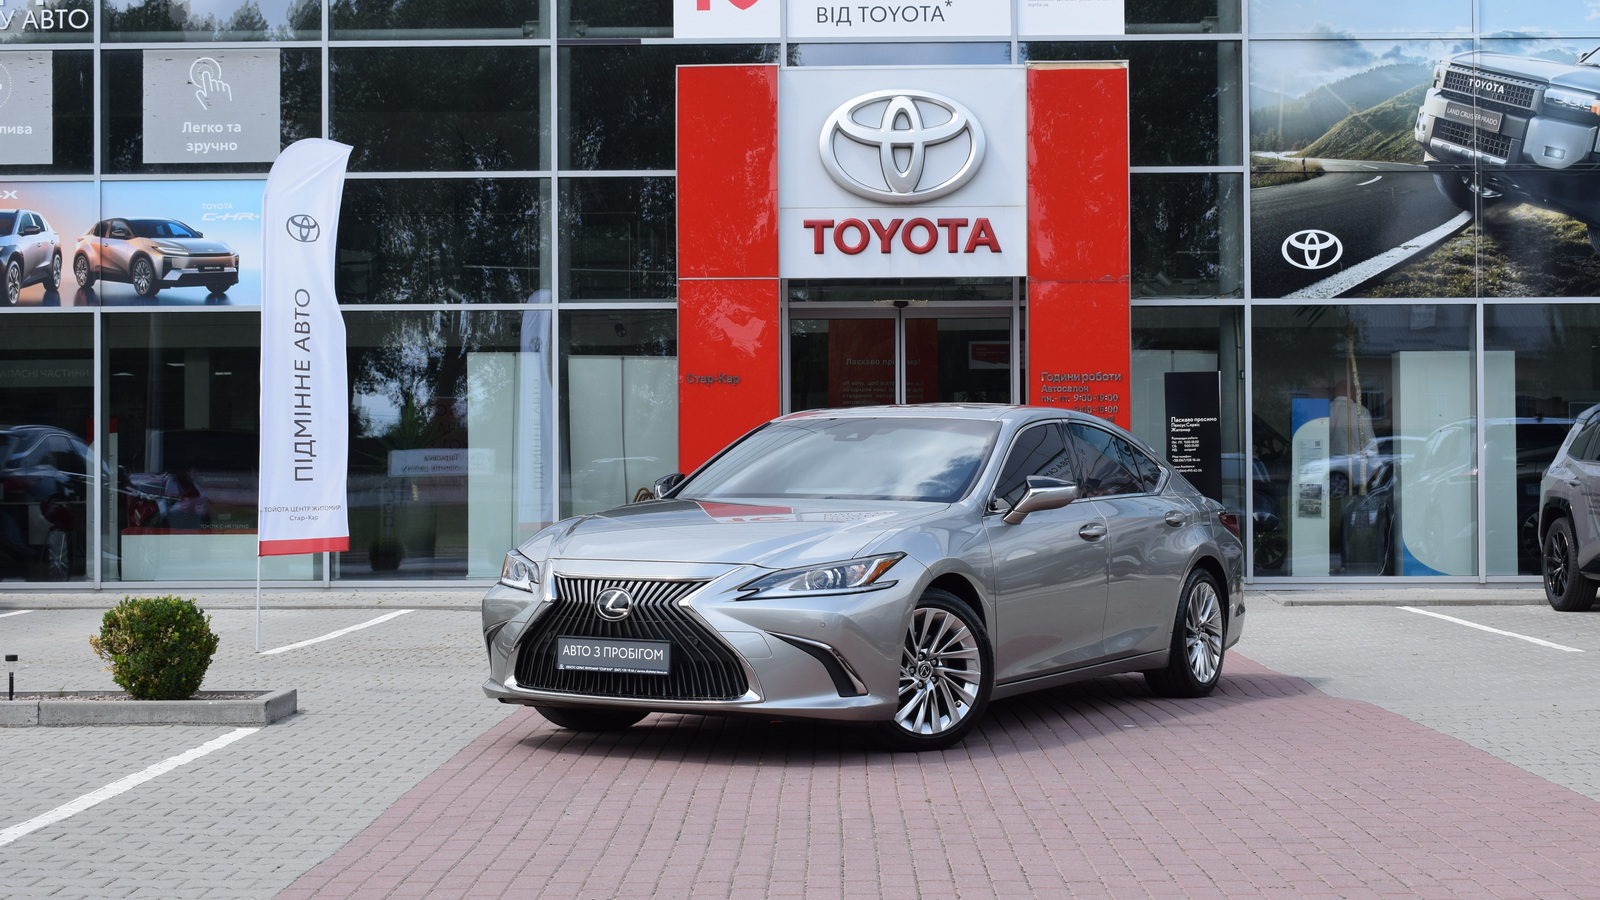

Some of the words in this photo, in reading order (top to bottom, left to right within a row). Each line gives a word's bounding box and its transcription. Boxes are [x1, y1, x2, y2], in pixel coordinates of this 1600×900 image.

[22, 8, 90, 30] АВТО
[816, 6, 852, 27] ВІД
[1469, 78, 1504, 94] TOYOTA
[1447, 108, 1460, 116] LAND
[1459, 110, 1481, 121] CRUISER
[1480, 115, 1498, 126] PRADO
[181, 121, 224, 134] Легко
[226, 123, 242, 133] та
[186, 142, 238, 154] зручно
[0, 189, 18, 200] X
[803, 217, 1002, 255] TOYOTA
[294, 288, 311, 353] АВТО
[882, 358, 921, 367] промо!
[40, 368, 89, 378] ЧАСТИНИ
[685, 373, 741, 385] Стар-Кар
[1041, 371, 1081, 384] Години
[1081, 370, 1122, 384] роботи
[1041, 384, 1090, 393] Автосалон
[1073, 393, 1119, 402] 9:00-19:00
[294, 359, 317, 481] ПІДМІННЕ
[264, 505, 290, 513] ТОЙОТА
[290, 505, 312, 513] ЦЕНТР
[311, 504, 342, 512] ЖИТОМИР
[289, 514, 319, 522] Стар-Кар
[562, 644, 592, 657] АВТО
[603, 646, 664, 661] ПРОБІГОМ
